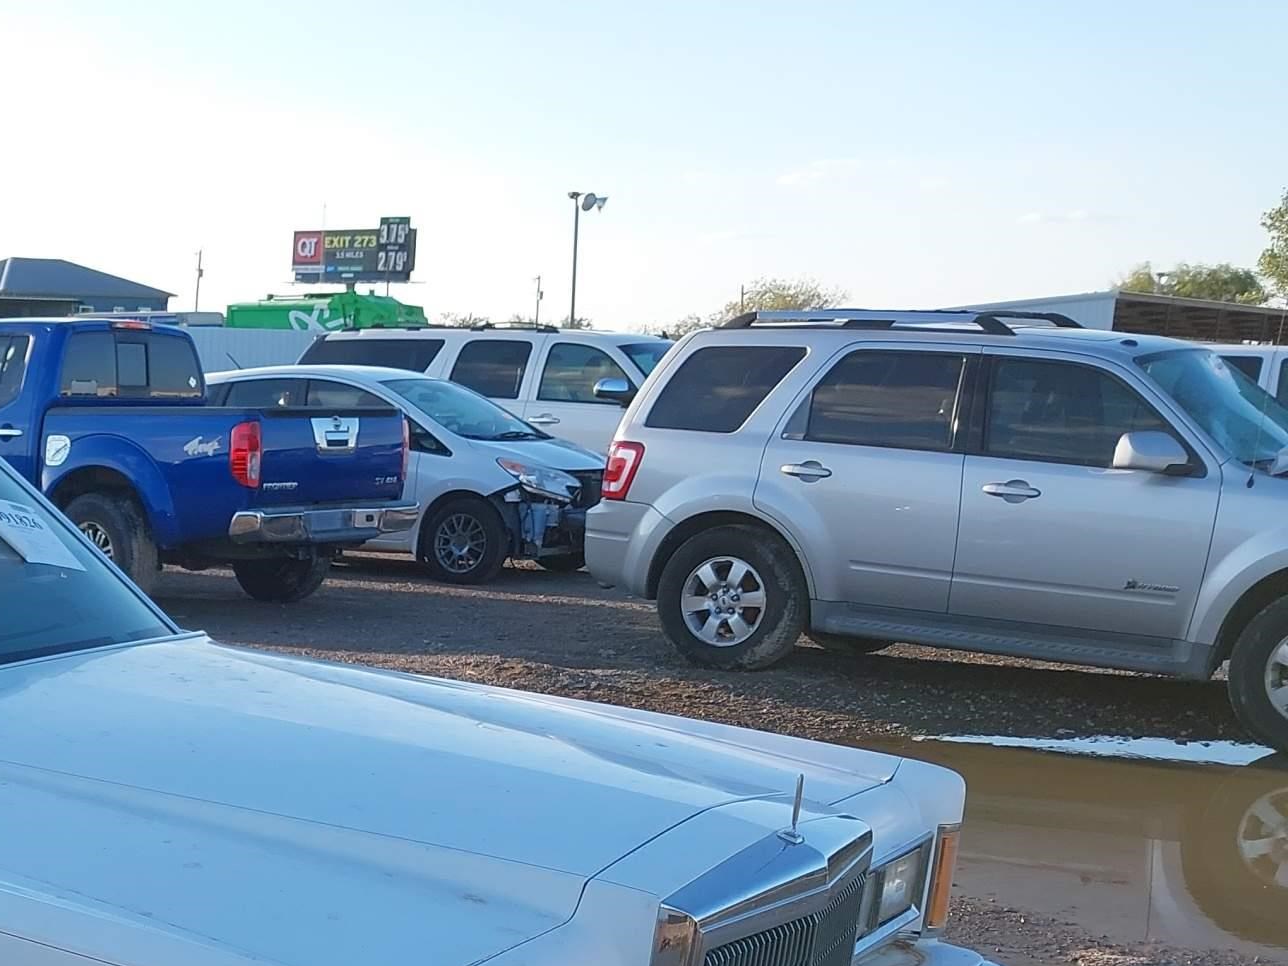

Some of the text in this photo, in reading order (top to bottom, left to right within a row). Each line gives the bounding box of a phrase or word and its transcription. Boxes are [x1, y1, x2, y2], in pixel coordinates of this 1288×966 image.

[297, 238, 317, 257] QT
[324, 235, 377, 249] EXIT 273
